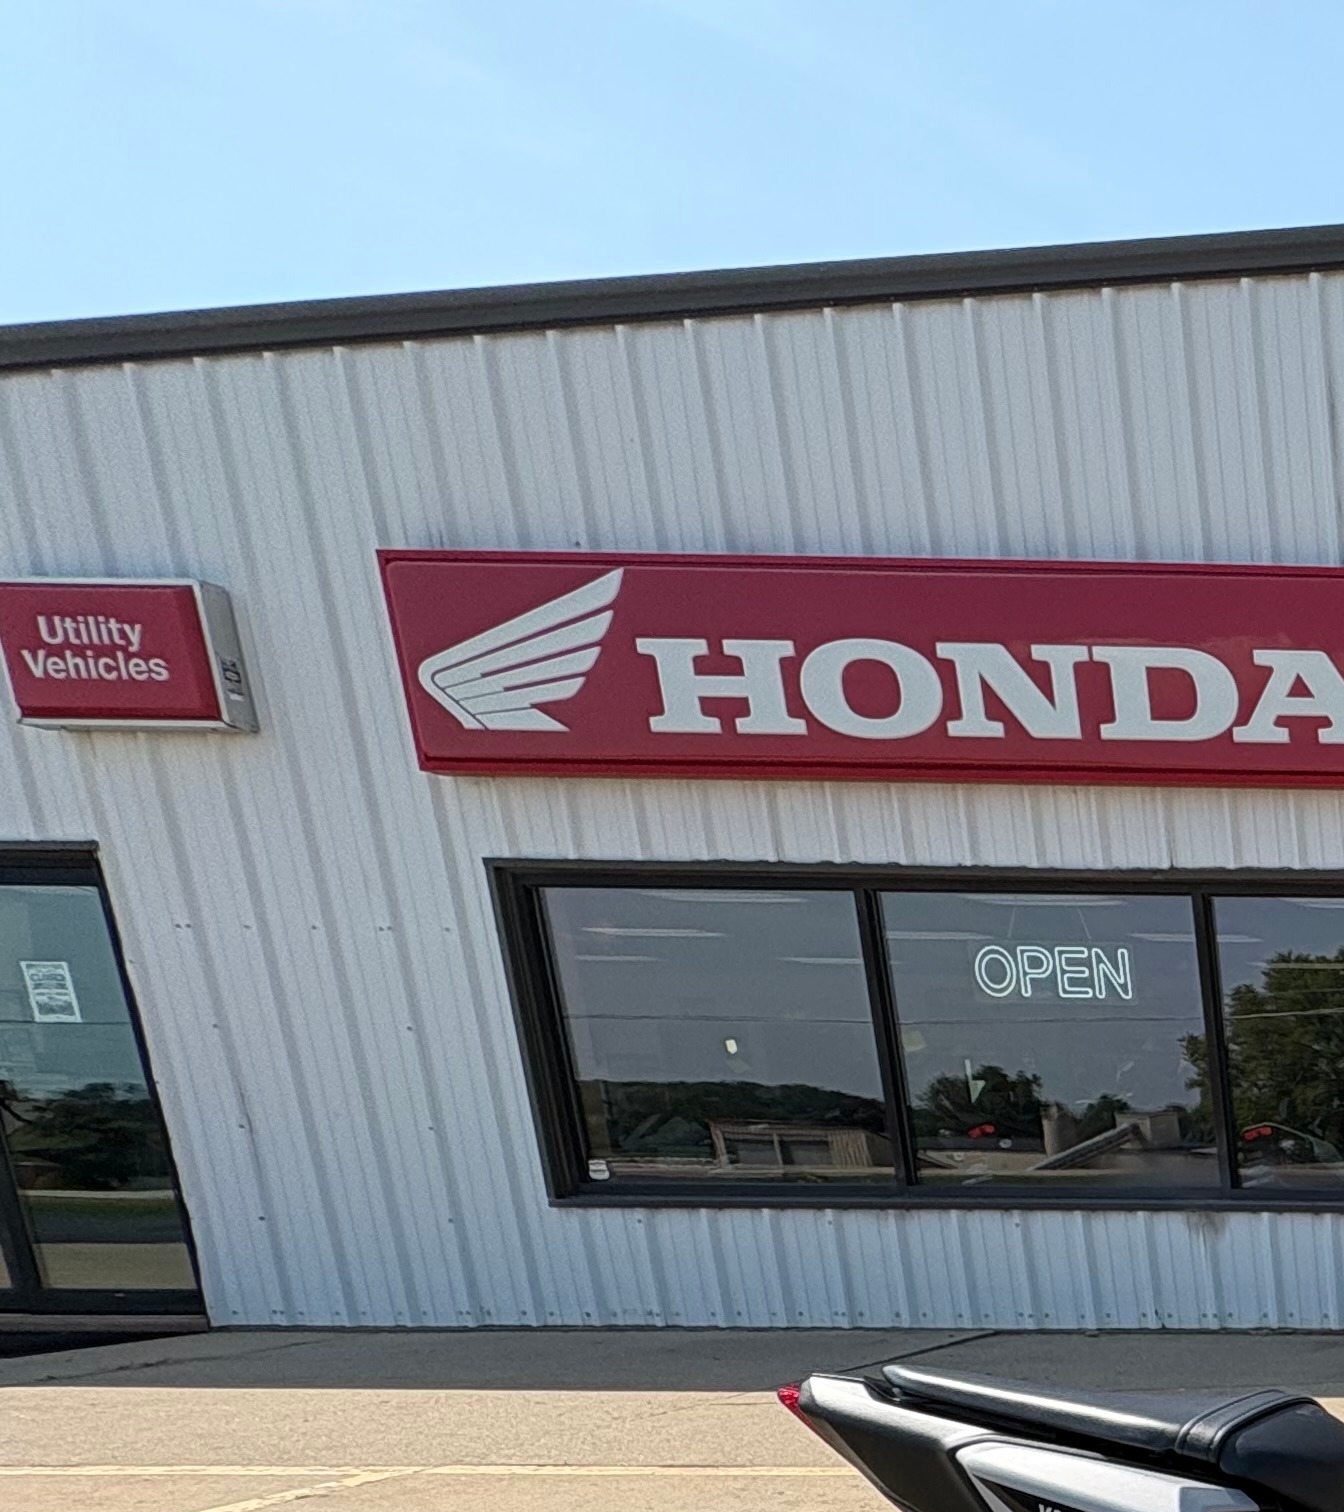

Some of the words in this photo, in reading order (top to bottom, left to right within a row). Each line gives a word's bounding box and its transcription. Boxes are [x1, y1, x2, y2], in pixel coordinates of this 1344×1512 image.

[36, 615, 142, 652] Utility
[21, 649, 170, 681] Vehicles
[974, 945, 1133, 1000] OPEN
